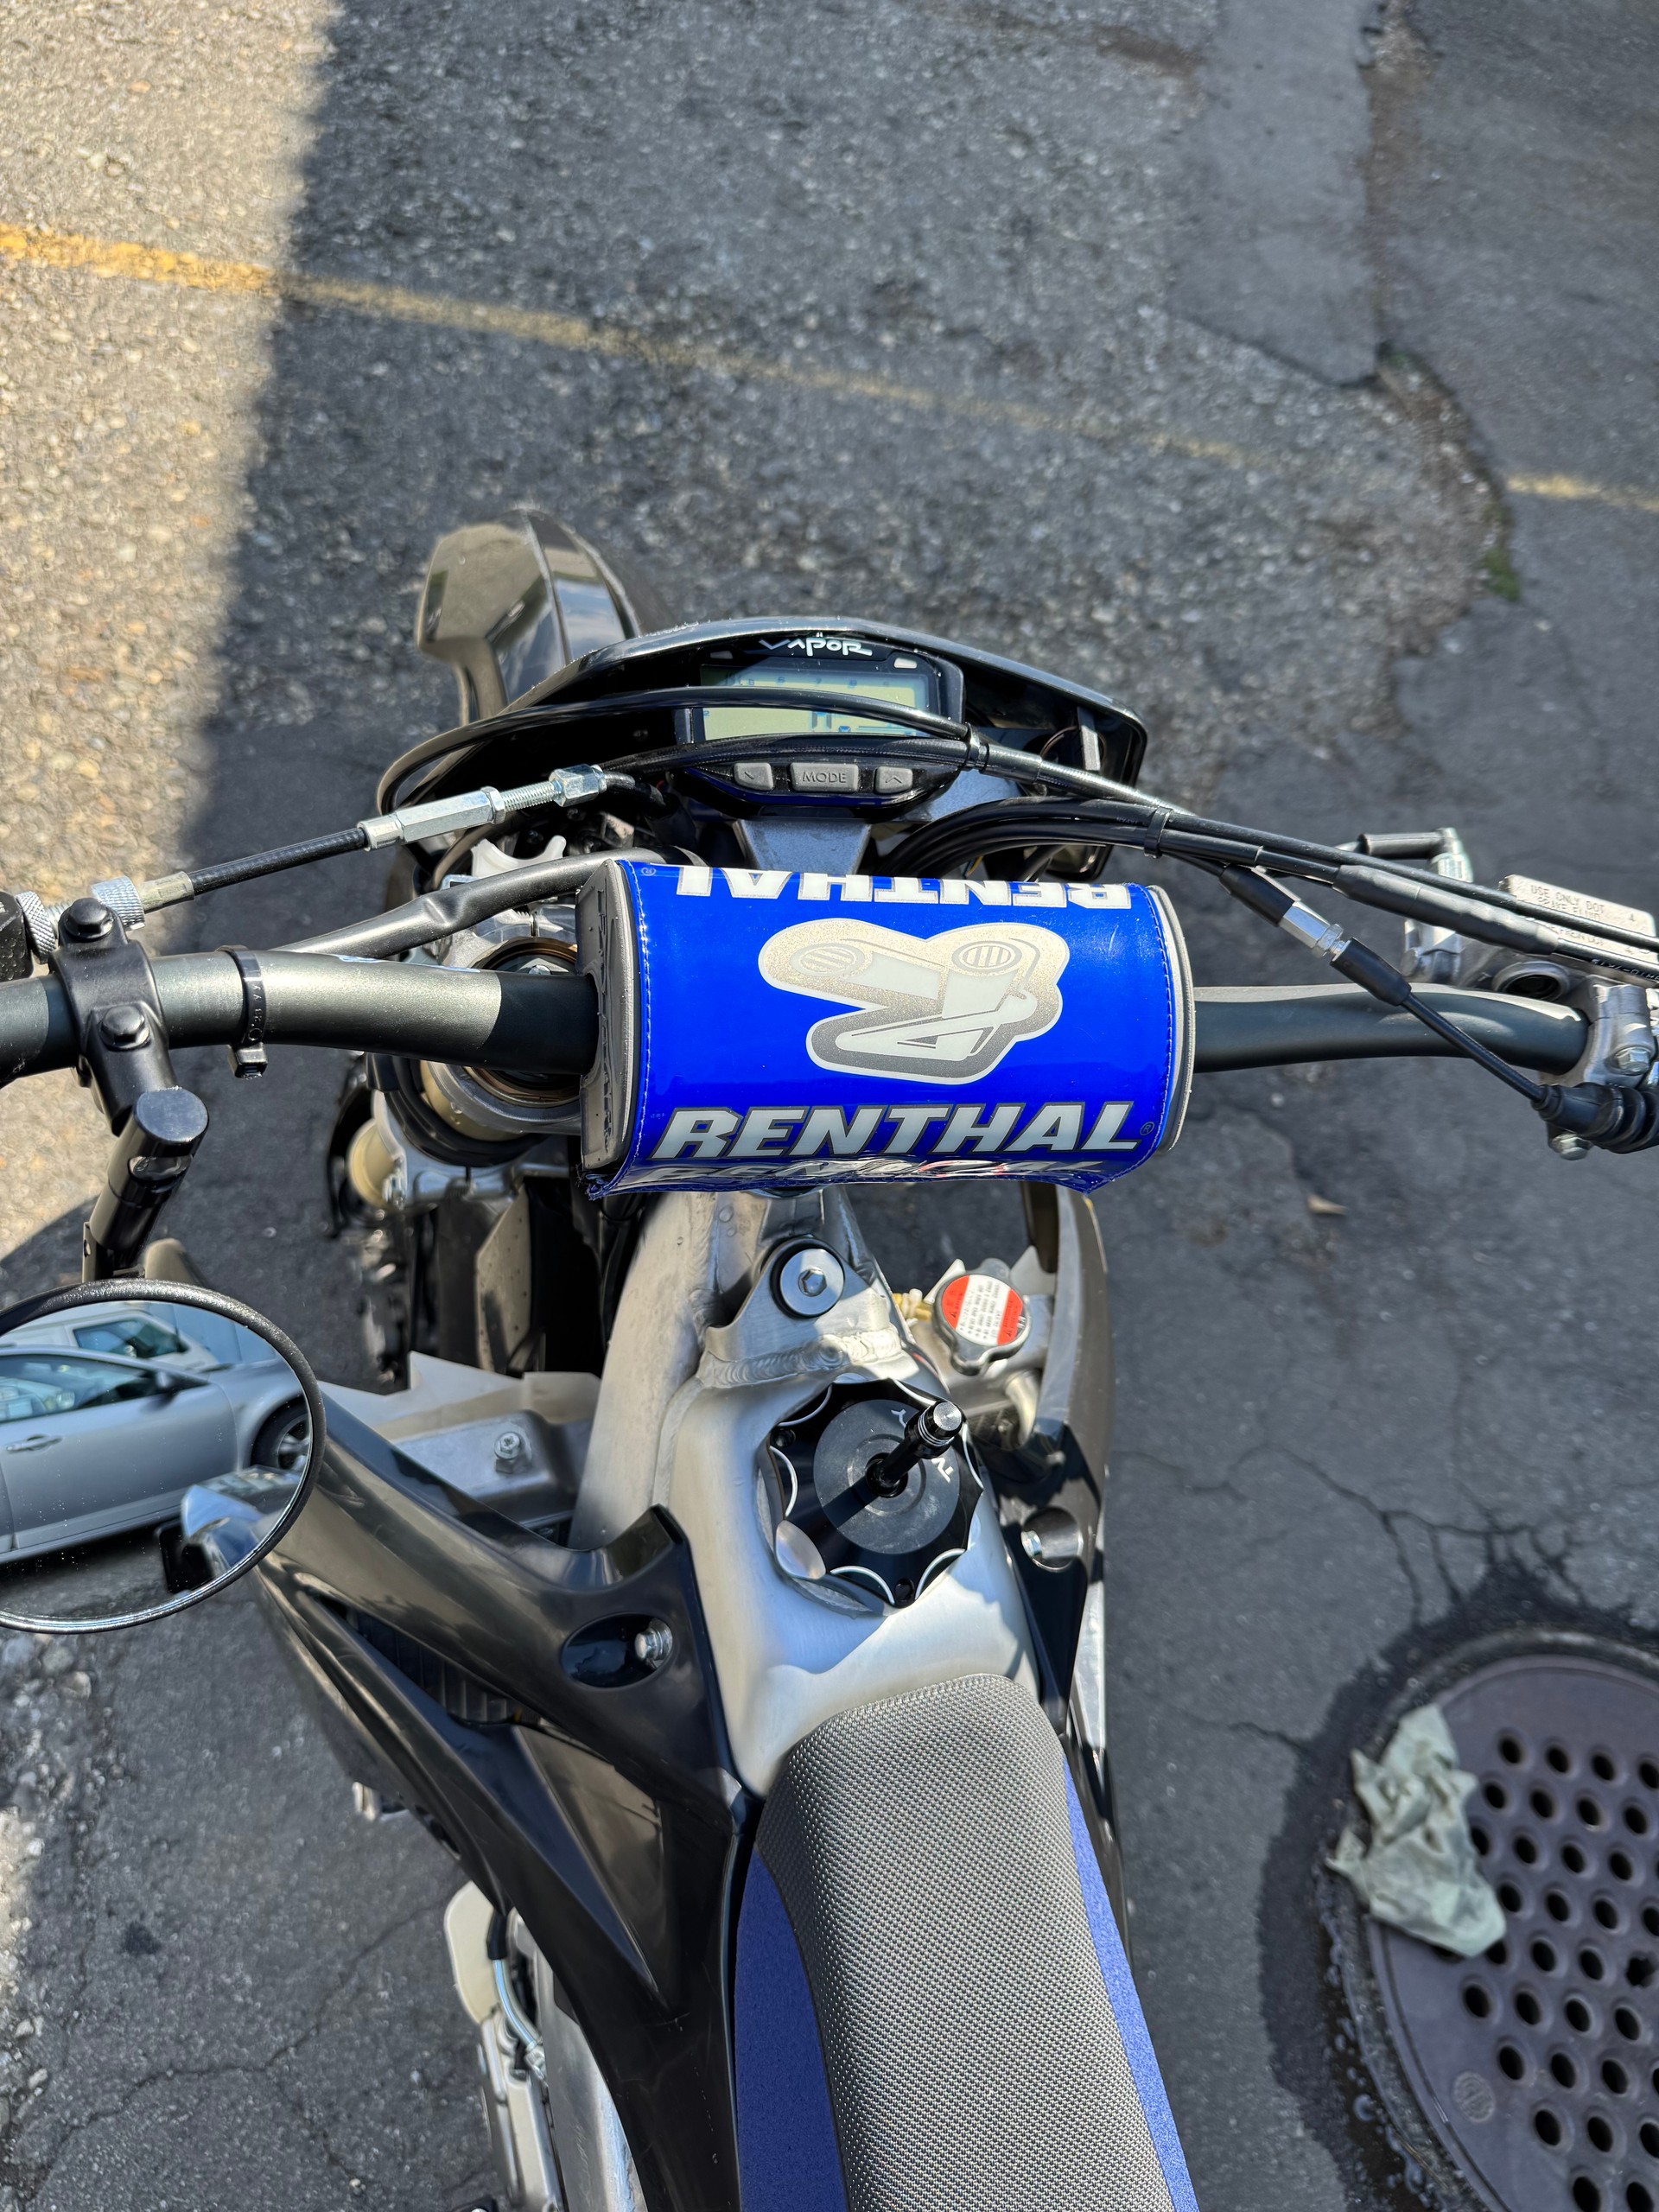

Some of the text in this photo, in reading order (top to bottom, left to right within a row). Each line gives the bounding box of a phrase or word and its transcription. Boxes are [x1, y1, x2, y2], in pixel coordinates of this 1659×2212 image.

[759, 637, 873, 657] VAPOR
[802, 771, 847, 784] MODE
[1531, 885, 1549, 899] USE
[1555, 892, 1580, 906] ONLY
[1586, 900, 1605, 913] DOT
[647, 1101, 1142, 1160] RENTHAL
